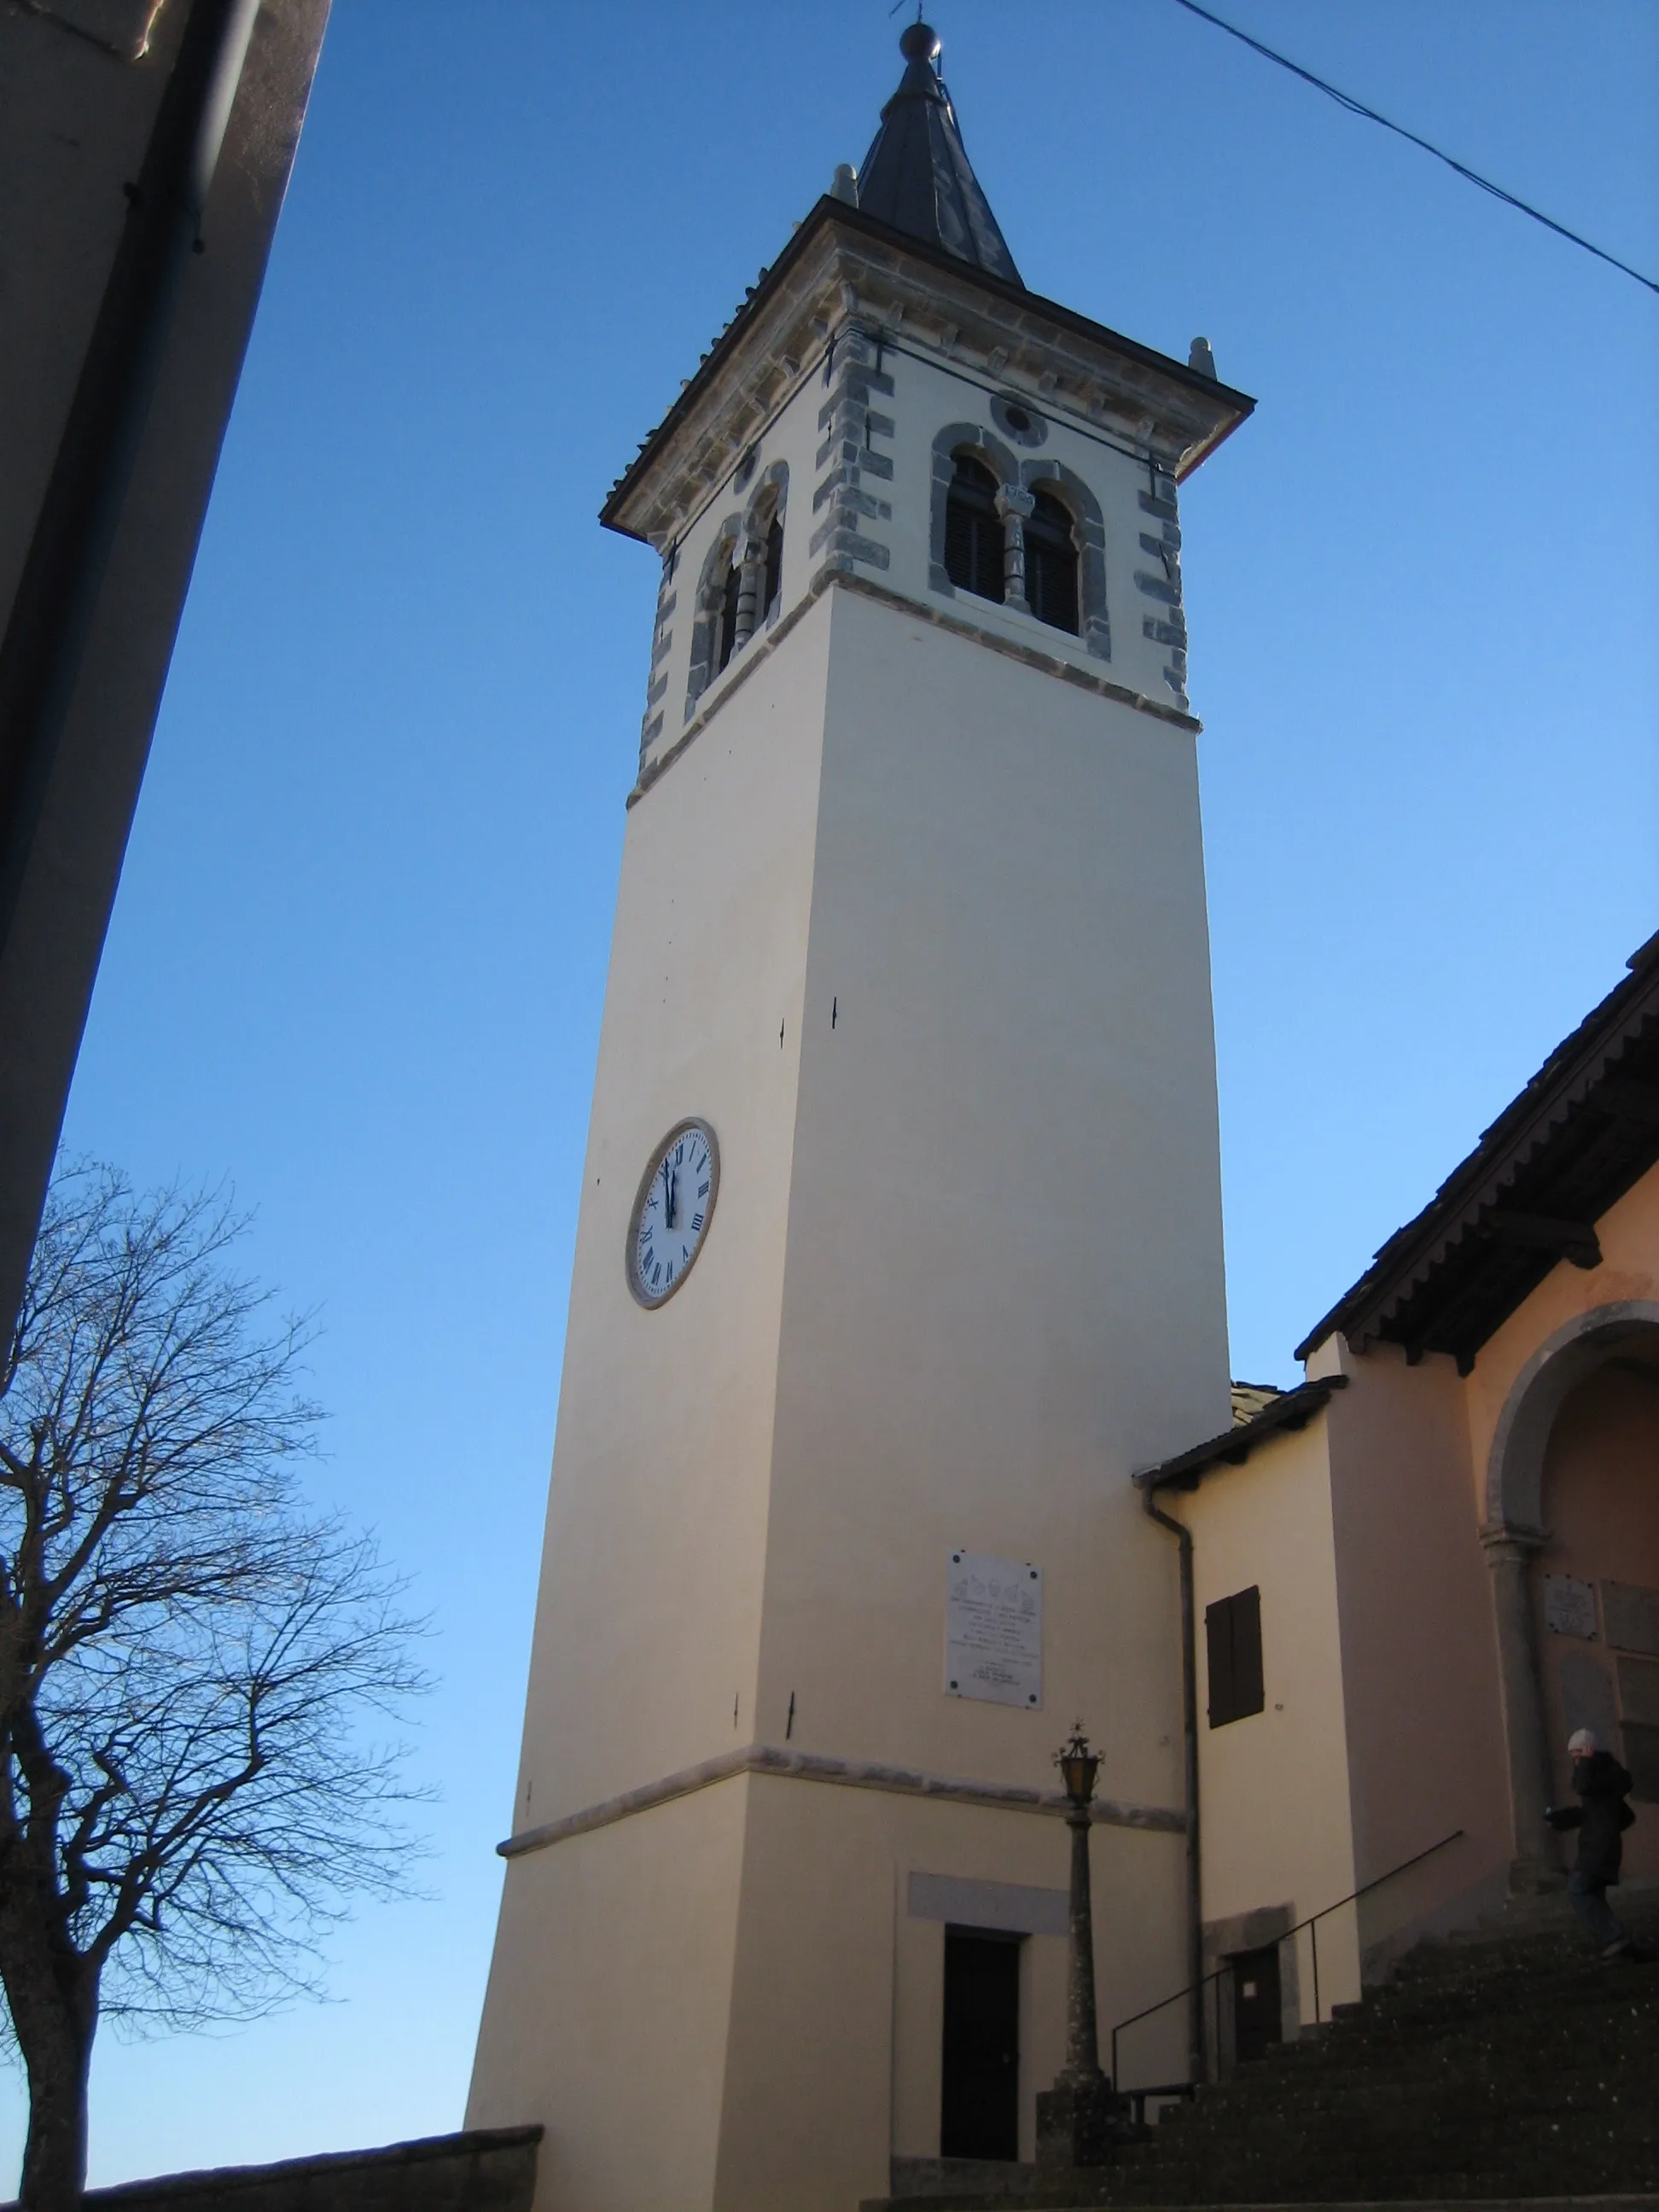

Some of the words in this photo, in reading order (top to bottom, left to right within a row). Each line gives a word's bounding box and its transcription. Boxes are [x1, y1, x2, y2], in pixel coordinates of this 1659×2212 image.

[697, 1181, 709, 1198] III
[649, 1197, 659, 1210] X
[641, 1225, 654, 1244] IX
[682, 1245, 689, 1263] V
